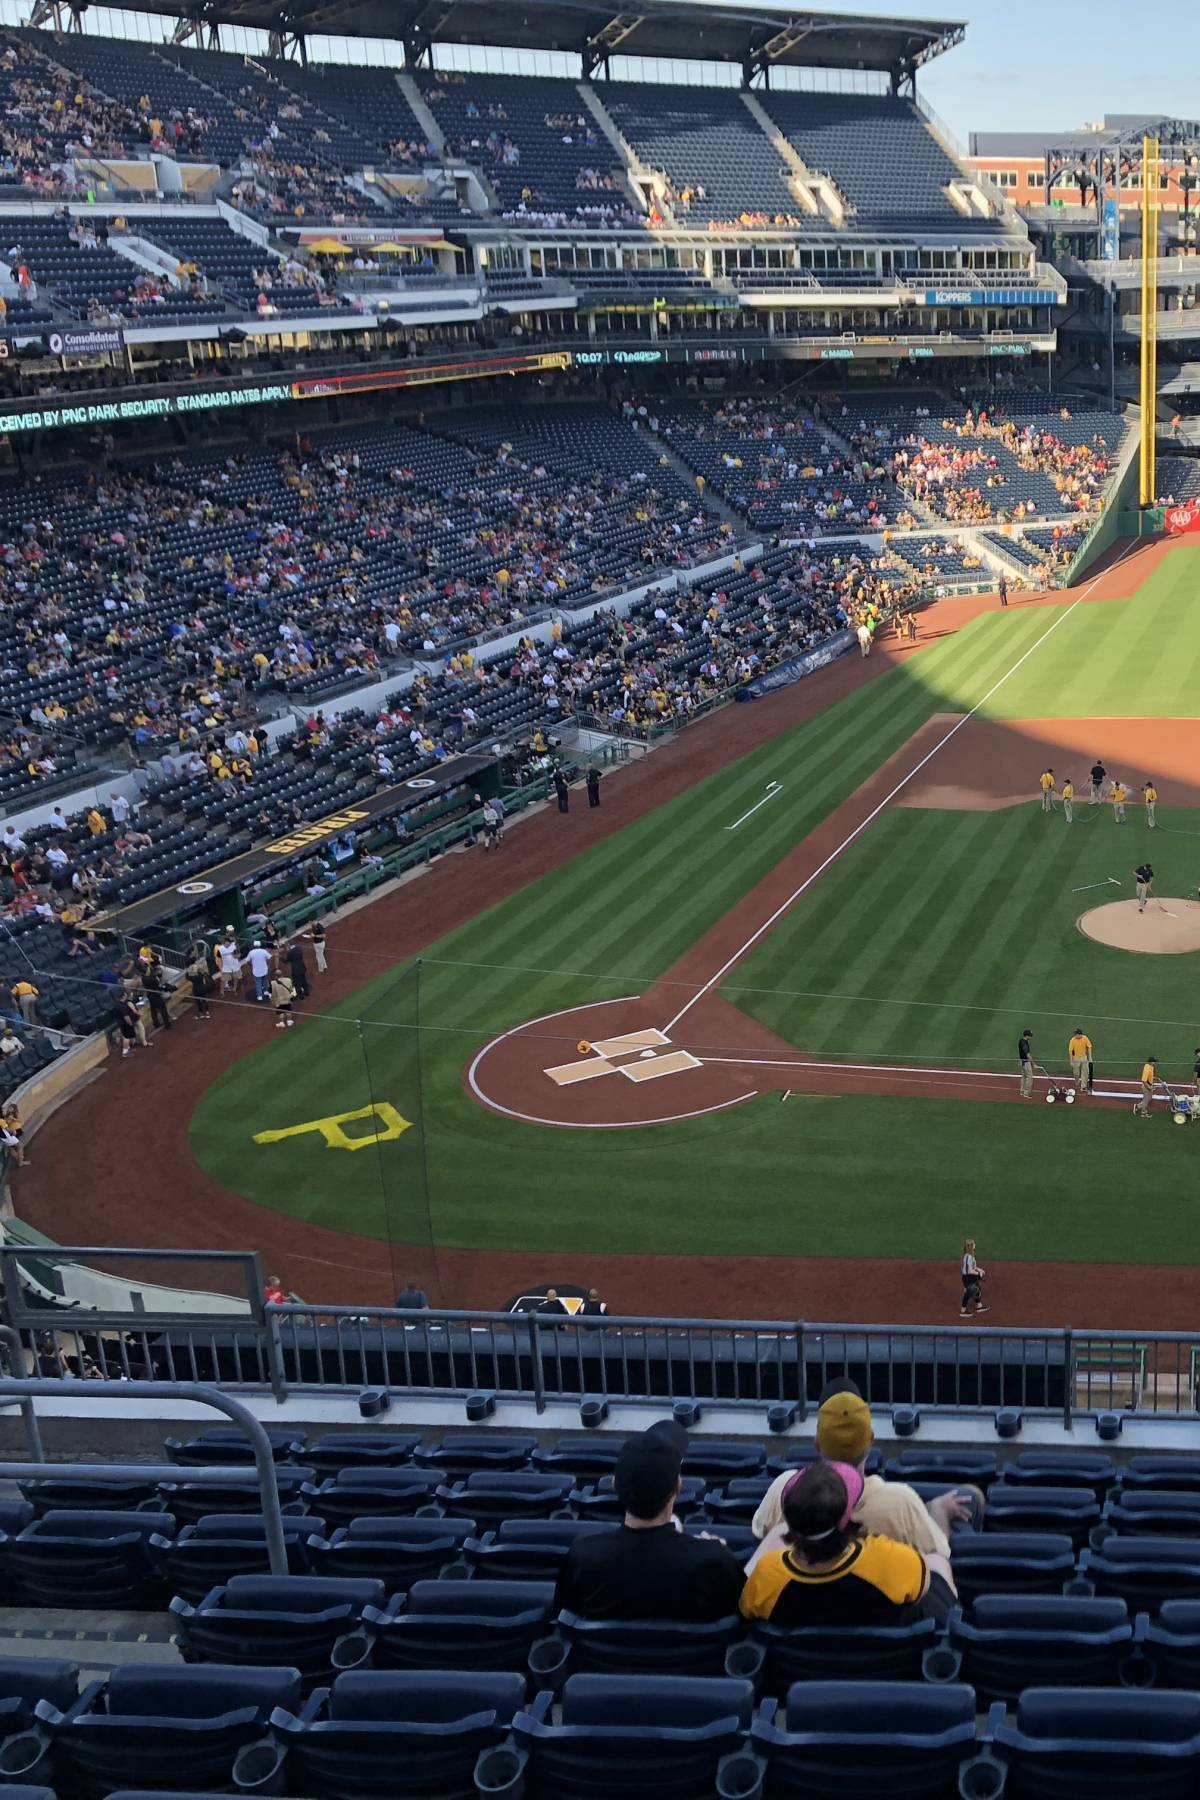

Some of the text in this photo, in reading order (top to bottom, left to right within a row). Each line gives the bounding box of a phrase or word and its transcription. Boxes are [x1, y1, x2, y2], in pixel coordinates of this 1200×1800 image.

[936, 291, 972, 302] KOPPERS
[65, 331, 118, 344] Consolidated
[65, 342, 121, 352] communications
[0, 412, 41, 432] CEIVED
[44, 411, 59, 426] BY
[62, 408, 87, 424] PNC
[89, 403, 119, 422] PARK
[177, 393, 229, 410] STANDARD
[232, 390, 261, 406] RATES
[1171, 511, 1191, 525] AAA
